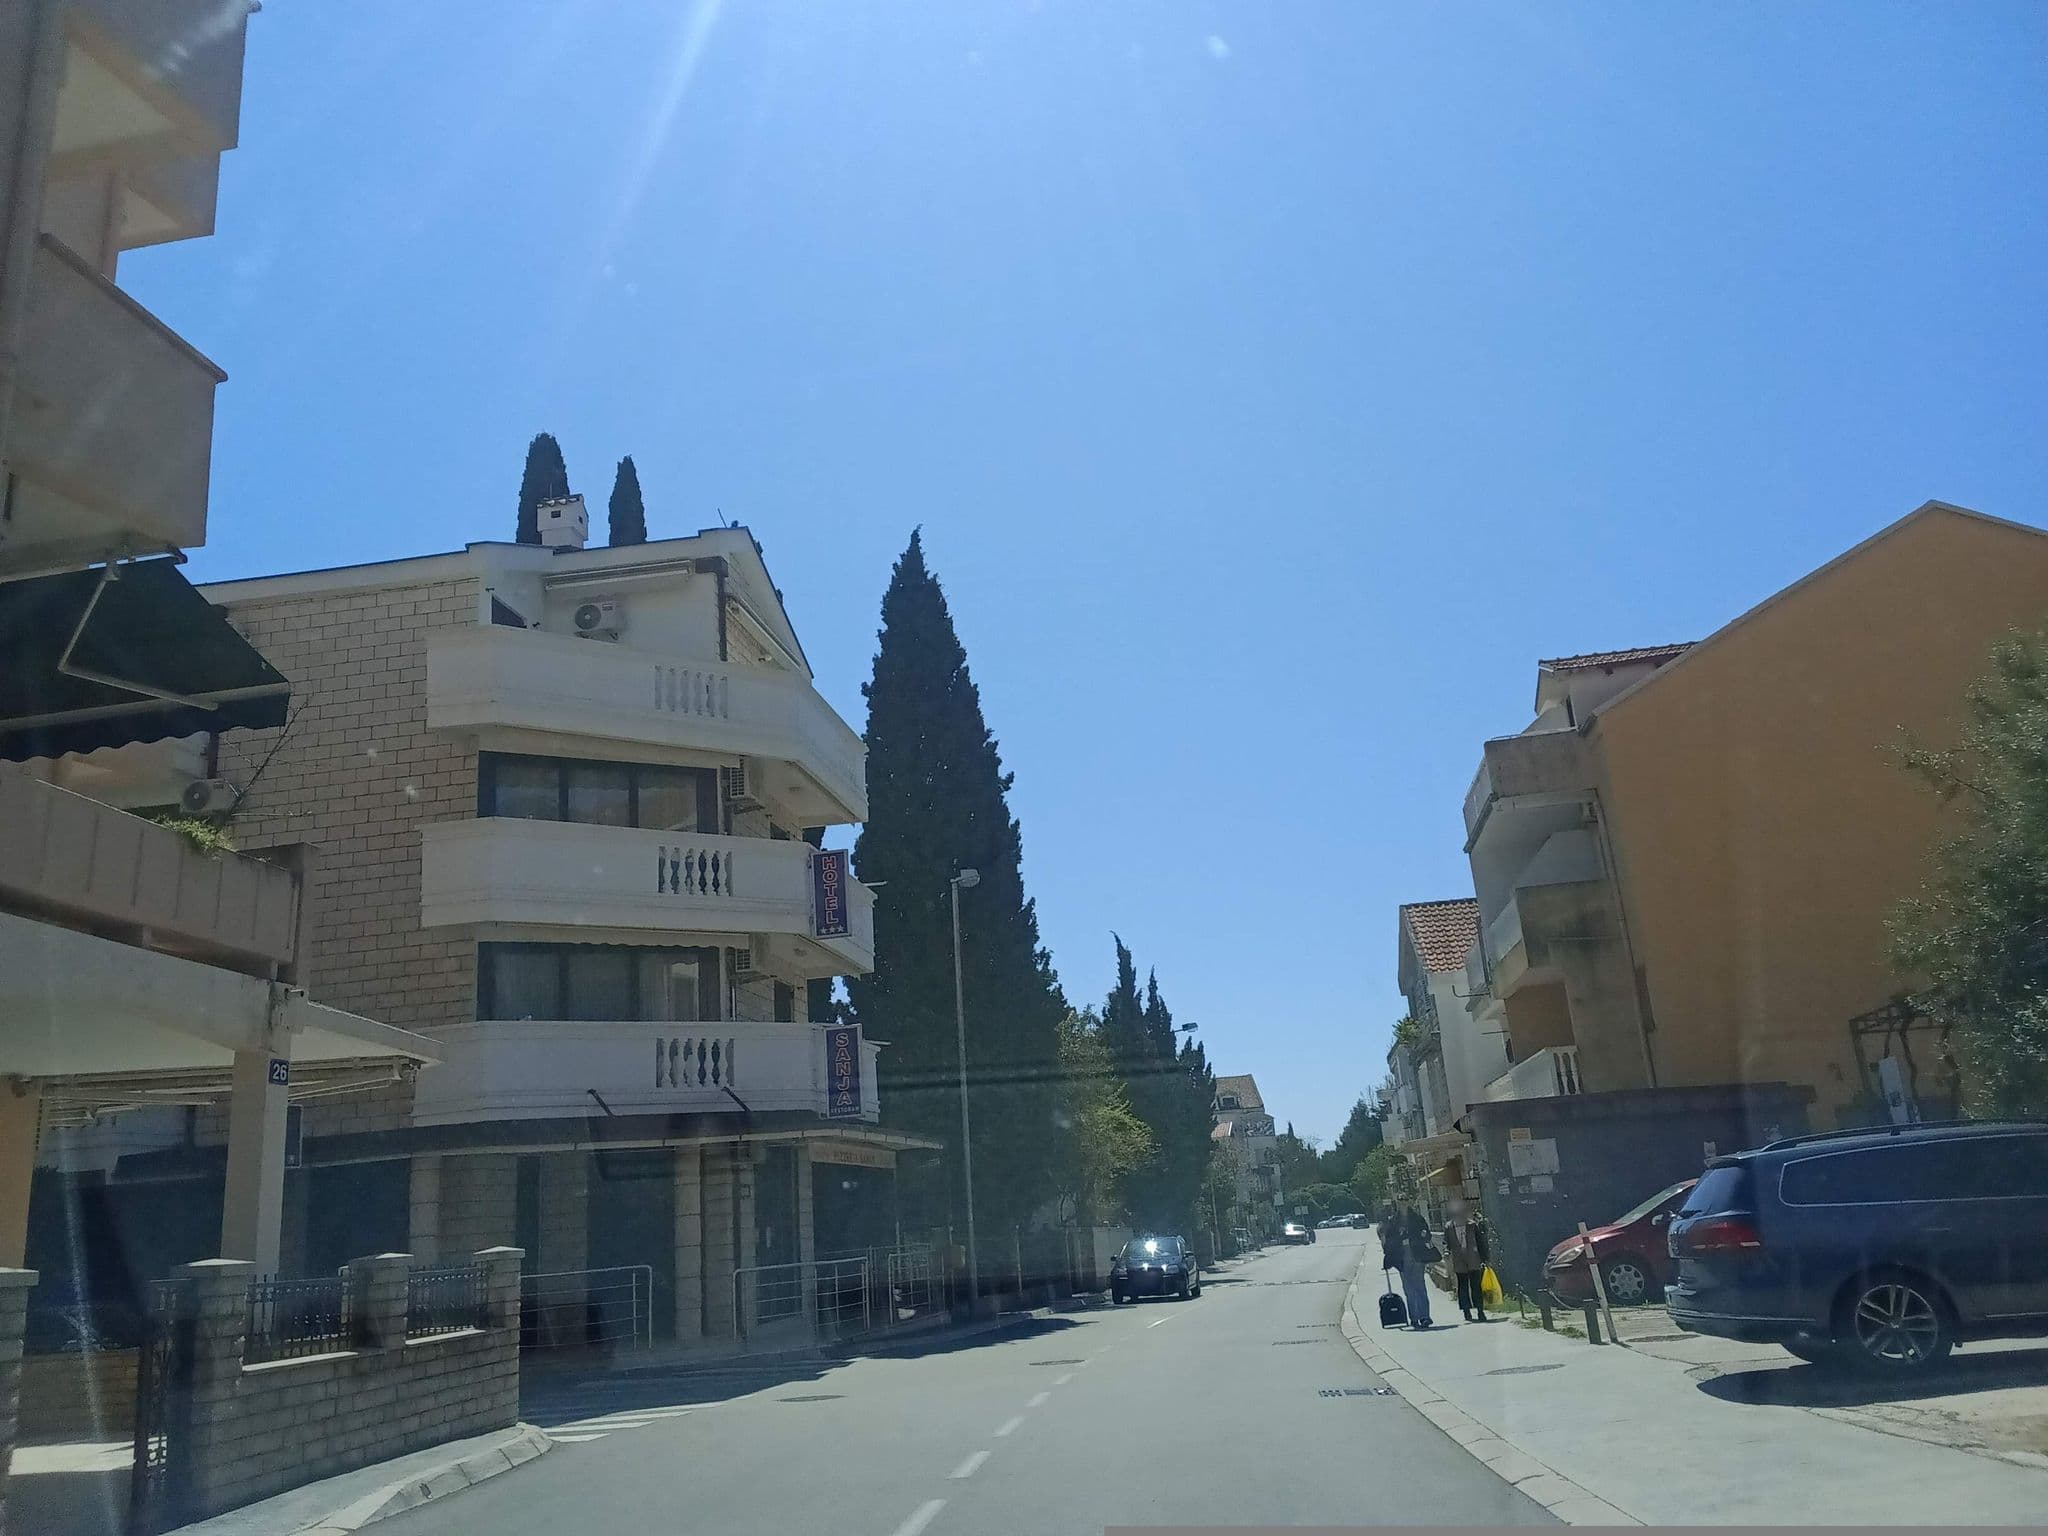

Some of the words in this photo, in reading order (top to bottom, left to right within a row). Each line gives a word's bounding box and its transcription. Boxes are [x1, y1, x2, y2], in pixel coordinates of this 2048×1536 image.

[822, 856, 838, 924] HOTEL
[272, 1063, 287, 1081] 26
[835, 1032, 853, 1106] SANJA
